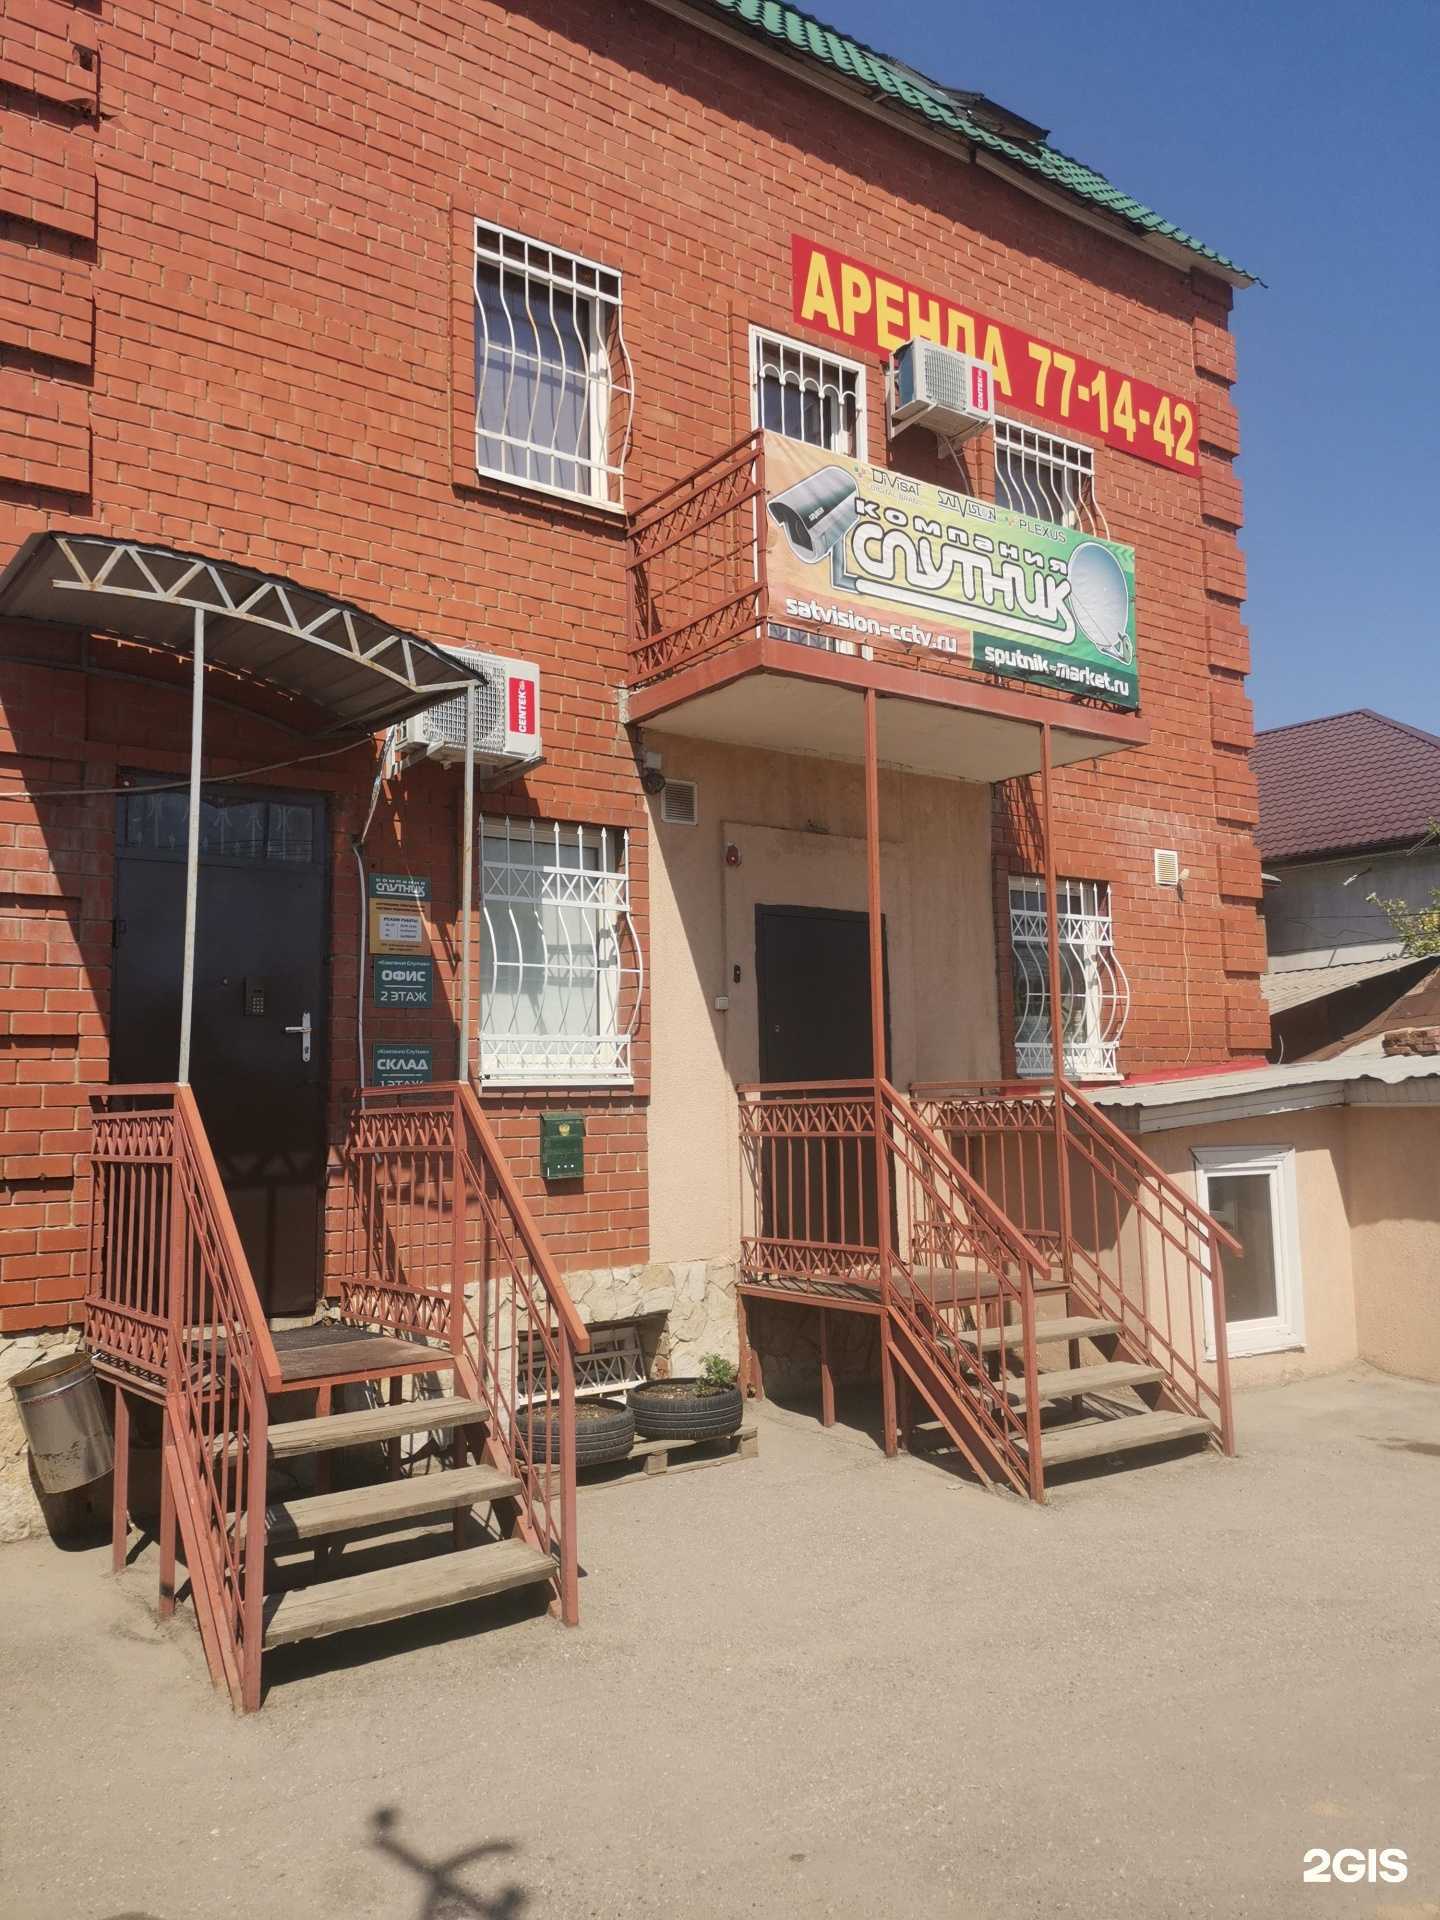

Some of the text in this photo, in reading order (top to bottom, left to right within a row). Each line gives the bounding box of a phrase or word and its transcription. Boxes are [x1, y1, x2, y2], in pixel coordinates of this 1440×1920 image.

[1028, 342, 1196, 466] 77-14-42
[1019, 519, 1066, 543] PLEXUS
[785, 597, 957, 653] satvision-cctv.ru
[984, 645, 1130, 697] sputnik-market.ru
[518, 688, 527, 733] CENTEK
[382, 970, 426, 982] ОФИС
[380, 991, 427, 1002] 2 ЭТАЖ
[377, 1059, 428, 1070] СКЛАД
